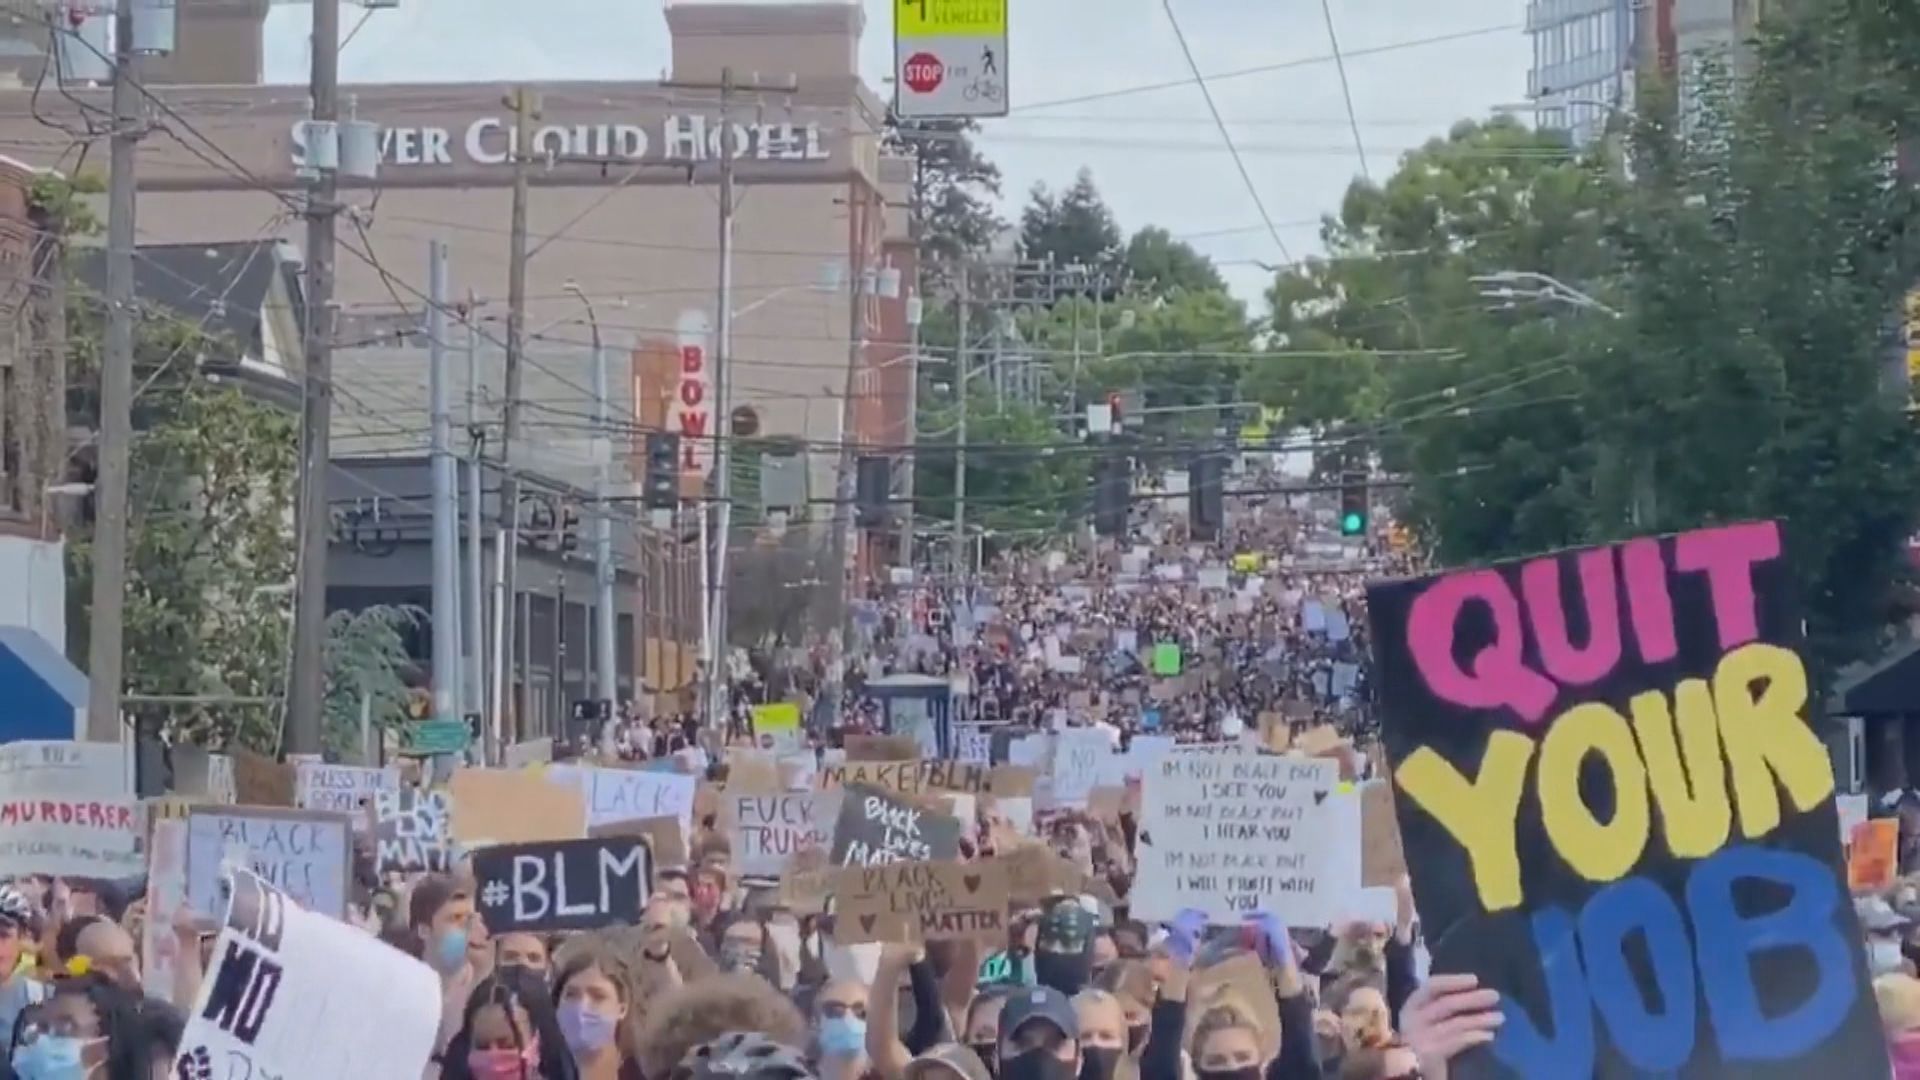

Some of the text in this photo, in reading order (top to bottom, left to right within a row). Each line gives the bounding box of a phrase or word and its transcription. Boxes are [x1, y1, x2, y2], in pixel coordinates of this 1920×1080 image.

[905, 63, 940, 82] STOP
[291, 120, 452, 165] SVER
[664, 113, 831, 161] HOTEL
[679, 346, 707, 470] BOWL
[1407, 520, 1782, 723] QUIT
[823, 764, 914, 793] MAKE
[1213, 783, 1248, 798] SEE
[1254, 783, 1287, 800] YOU
[1394, 642, 1836, 913] YOUR
[0, 801, 132, 830] MURDERER
[739, 797, 815, 824] FUCK
[219, 818, 325, 855] BLACK
[1217, 823, 1259, 840] HEAR
[1264, 826, 1291, 841] YOU
[480, 845, 648, 921] #BLM
[863, 865, 945, 894] BLACK
[1187, 875, 1218, 892] WILL
[1279, 877, 1316, 894] WITH
[1225, 894, 1259, 911] YOU
[920, 909, 1002, 932] MATTER
[1488, 845, 1859, 1080] JOB
